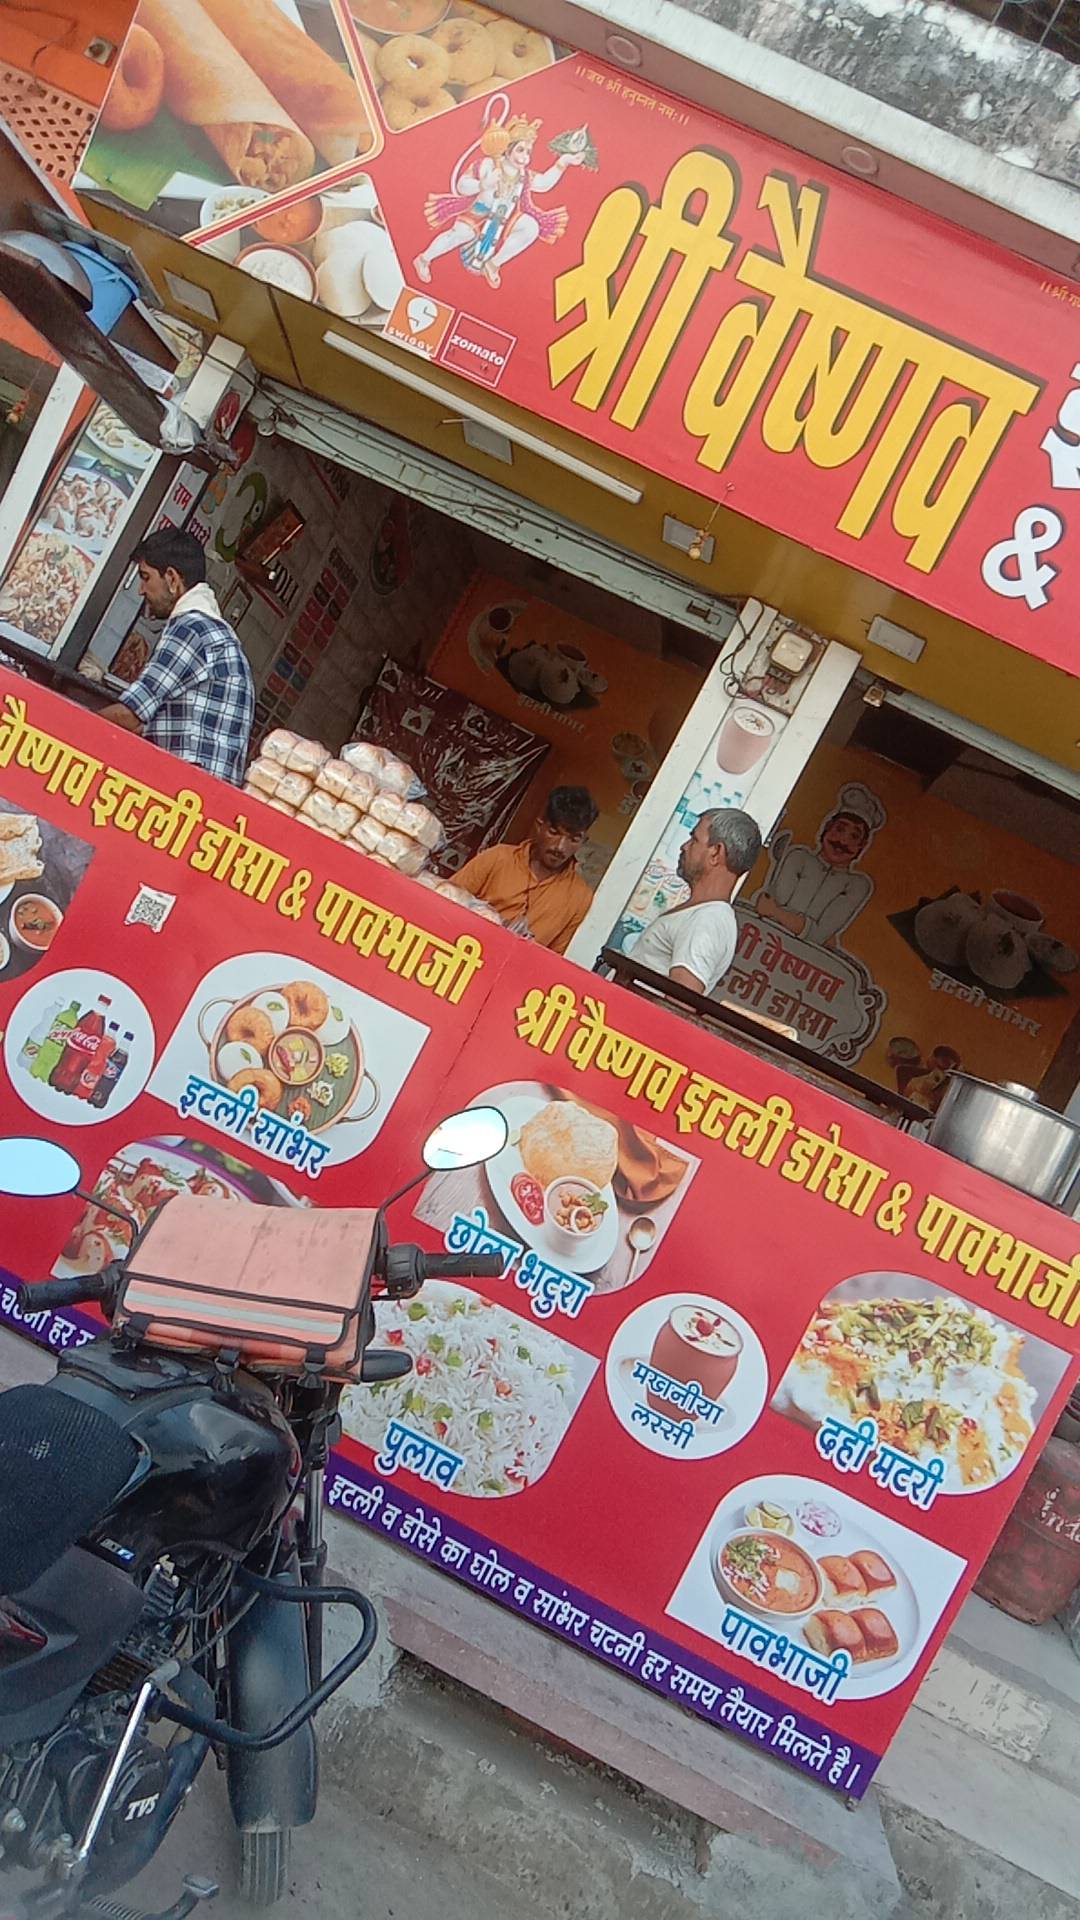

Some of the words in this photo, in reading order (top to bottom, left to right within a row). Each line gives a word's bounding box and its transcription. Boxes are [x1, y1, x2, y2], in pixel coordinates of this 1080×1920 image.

[388, 326, 434, 352] SWIGGY
[450, 334, 505, 366] zomato
[547, 150, 735, 432] श्री
[681, 174, 1043, 574] वैष्णव
[173, 482, 193, 512] राम
[978, 505, 1064, 612] &
[0, 693, 104, 807] वैष्णव
[90, 766, 204, 859] इटली
[189, 814, 291, 904] डोसा
[276, 869, 312, 921] &
[314, 879, 485, 1005] पावभाजी
[760, 932, 845, 1003] वैष्णव
[717, 966, 772, 1008] ली
[767, 988, 838, 1042] डोसा
[178, 1073, 258, 1135] इटली
[252, 1111, 332, 1175] सांभर
[514, 983, 578, 1055] श्री
[566, 994, 689, 1113] वैष्णव
[675, 1071, 795, 1168] इटली
[780, 1122, 890, 1218] डोसा
[874, 1181, 913, 1237] &
[916, 1193, 1080, 1328] पावभाजी
[517, 1251, 593, 1315] भटुरा
[48, 1315, 78, 1347] हर
[630, 1402, 696, 1450] लस्सी
[631, 1361, 725, 1426] मखनीया
[376, 1420, 464, 1488] पुलाव
[817, 1415, 877, 1470] दही
[869, 1445, 946, 1507] मटरी
[328, 1474, 385, 1521] इटली
[381, 1502, 402, 1531] व
[399, 1507, 441, 1553] डोसे
[440, 1536, 472, 1570] का
[469, 1549, 516, 1593] घोल
[513, 1576, 535, 1606] व
[532, 1589, 591, 1637] सांभर
[589, 1619, 647, 1668] चटनी
[640, 1649, 672, 1681] हर
[669, 1664, 723, 1711] समय
[719, 1686, 774, 1740] तैयार
[770, 1714, 832, 1772] मिलते
[719, 1606, 850, 1703] पावभाजी
[124, 1792, 160, 1822] TVS
